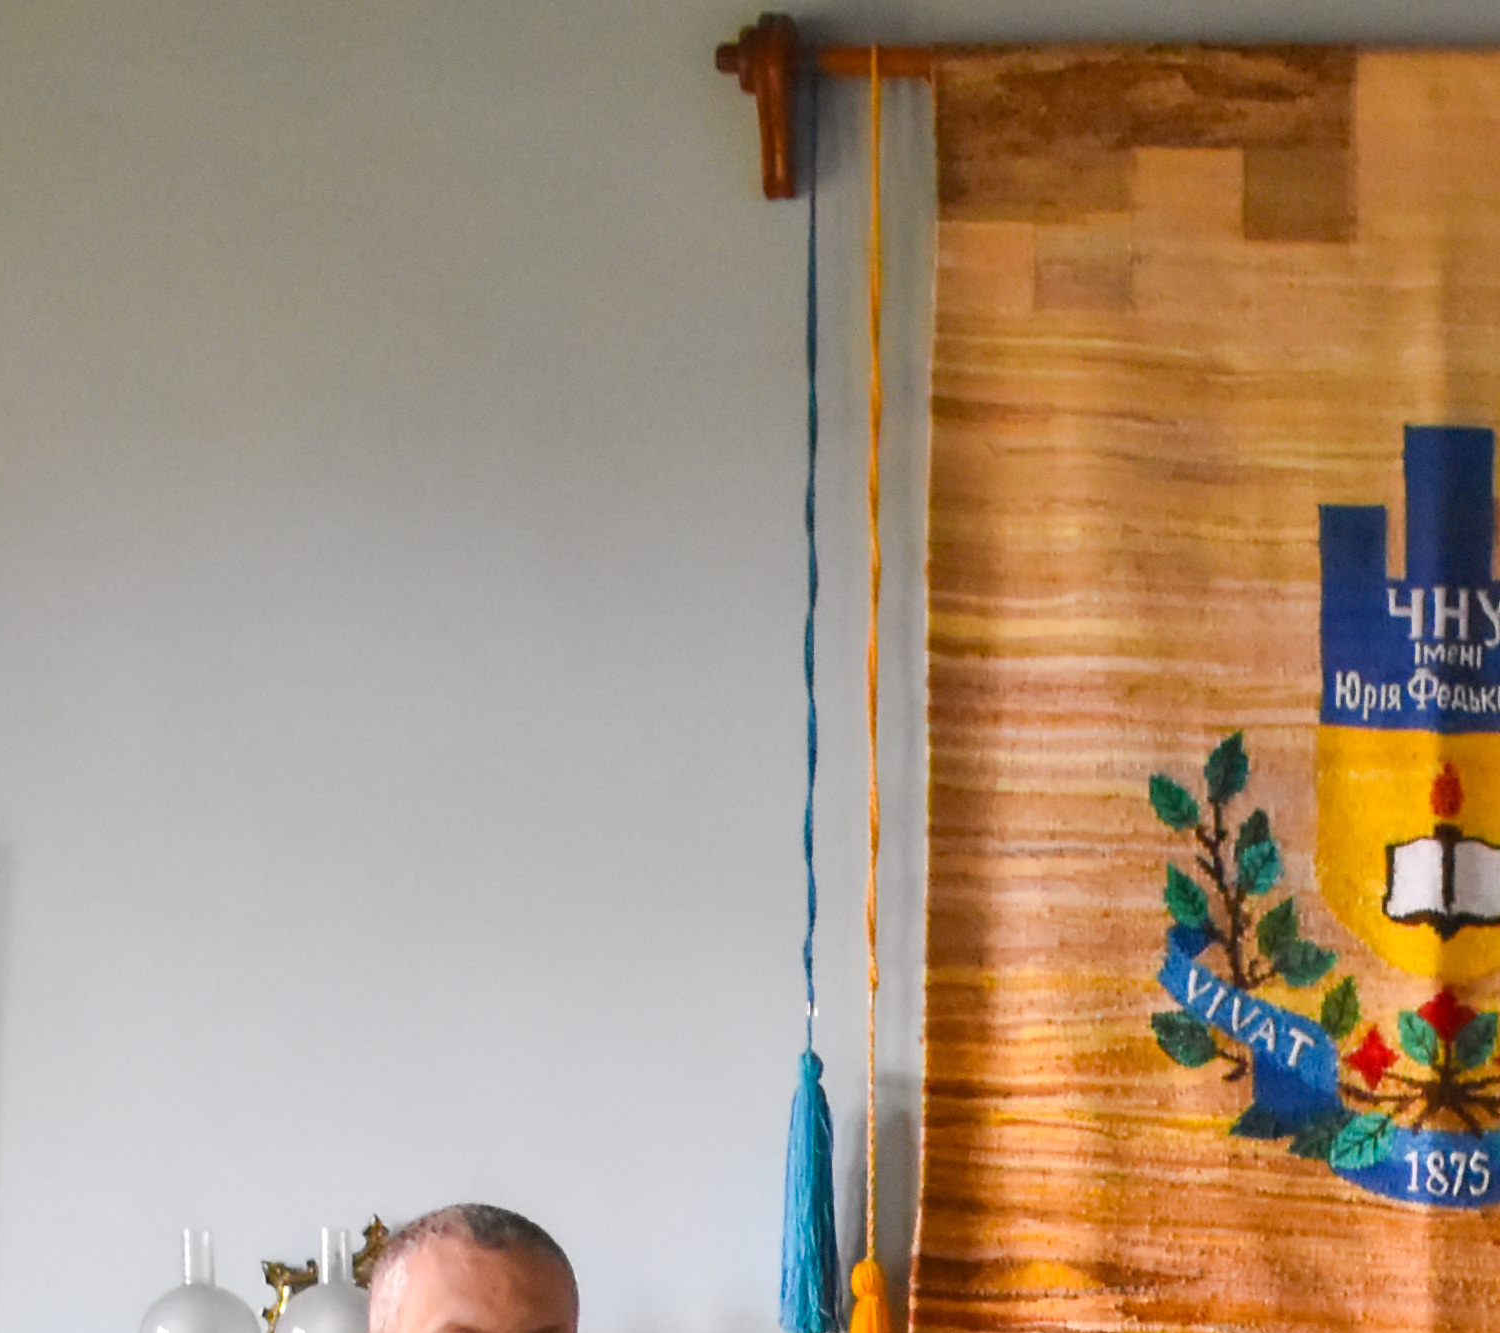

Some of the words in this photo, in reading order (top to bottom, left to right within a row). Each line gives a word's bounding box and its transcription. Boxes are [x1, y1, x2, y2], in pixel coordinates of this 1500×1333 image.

[1335, 670, 1402, 721] Юрія
[1184, 967, 1316, 1068] VIVAT
[1404, 1149, 1491, 1197] 1875
